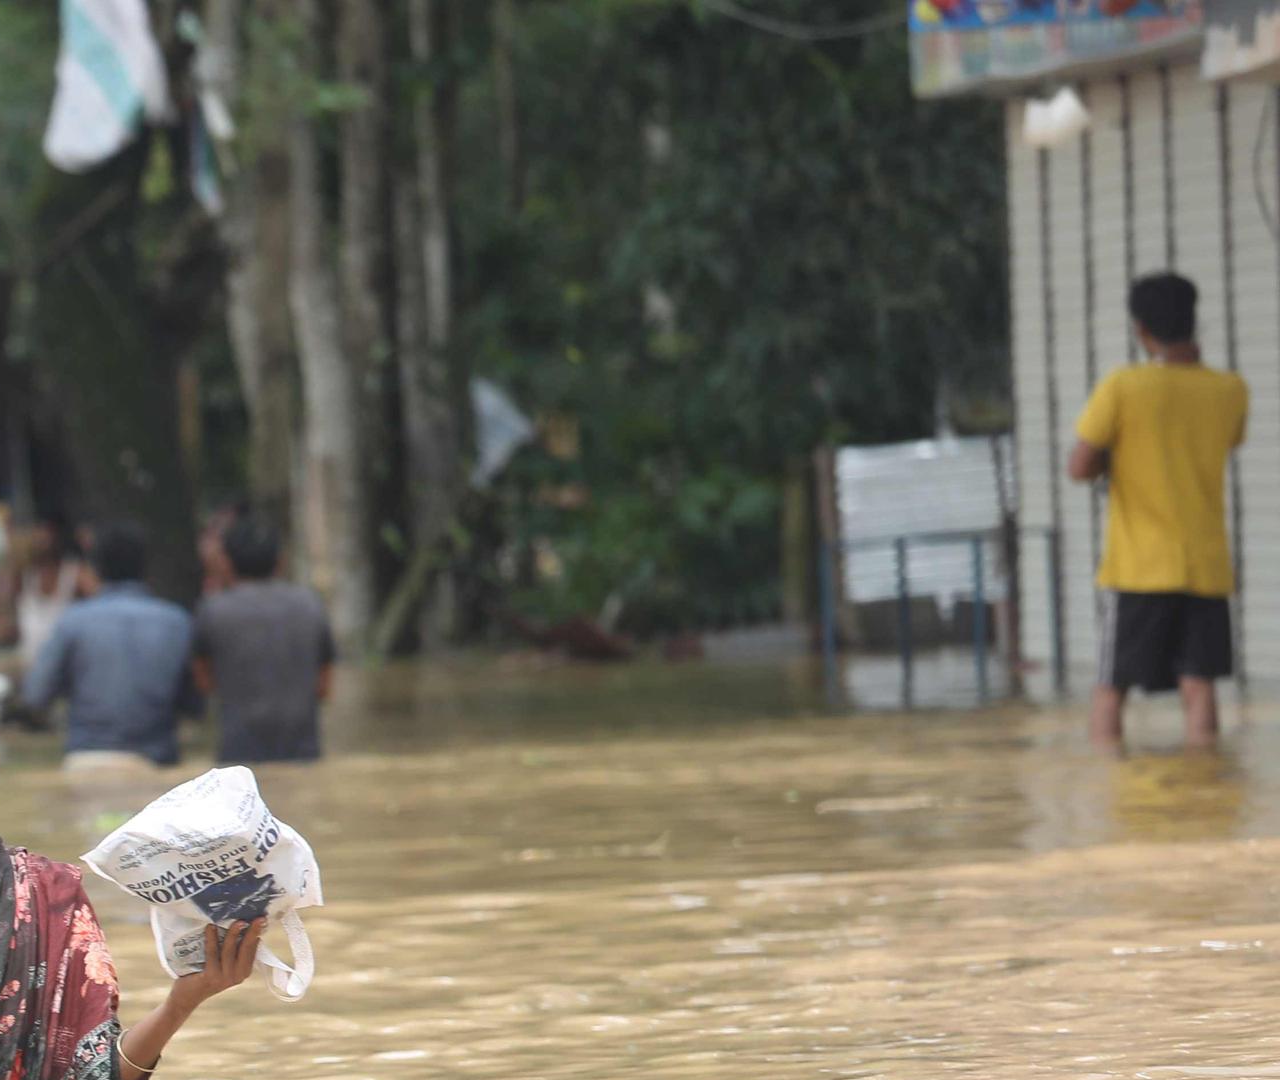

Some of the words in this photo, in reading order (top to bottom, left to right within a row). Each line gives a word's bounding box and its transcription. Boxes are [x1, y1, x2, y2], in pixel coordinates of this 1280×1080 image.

[220, 844, 248, 863] and
[177, 859, 218, 873] Baby
[126, 869, 177, 891] Wears
